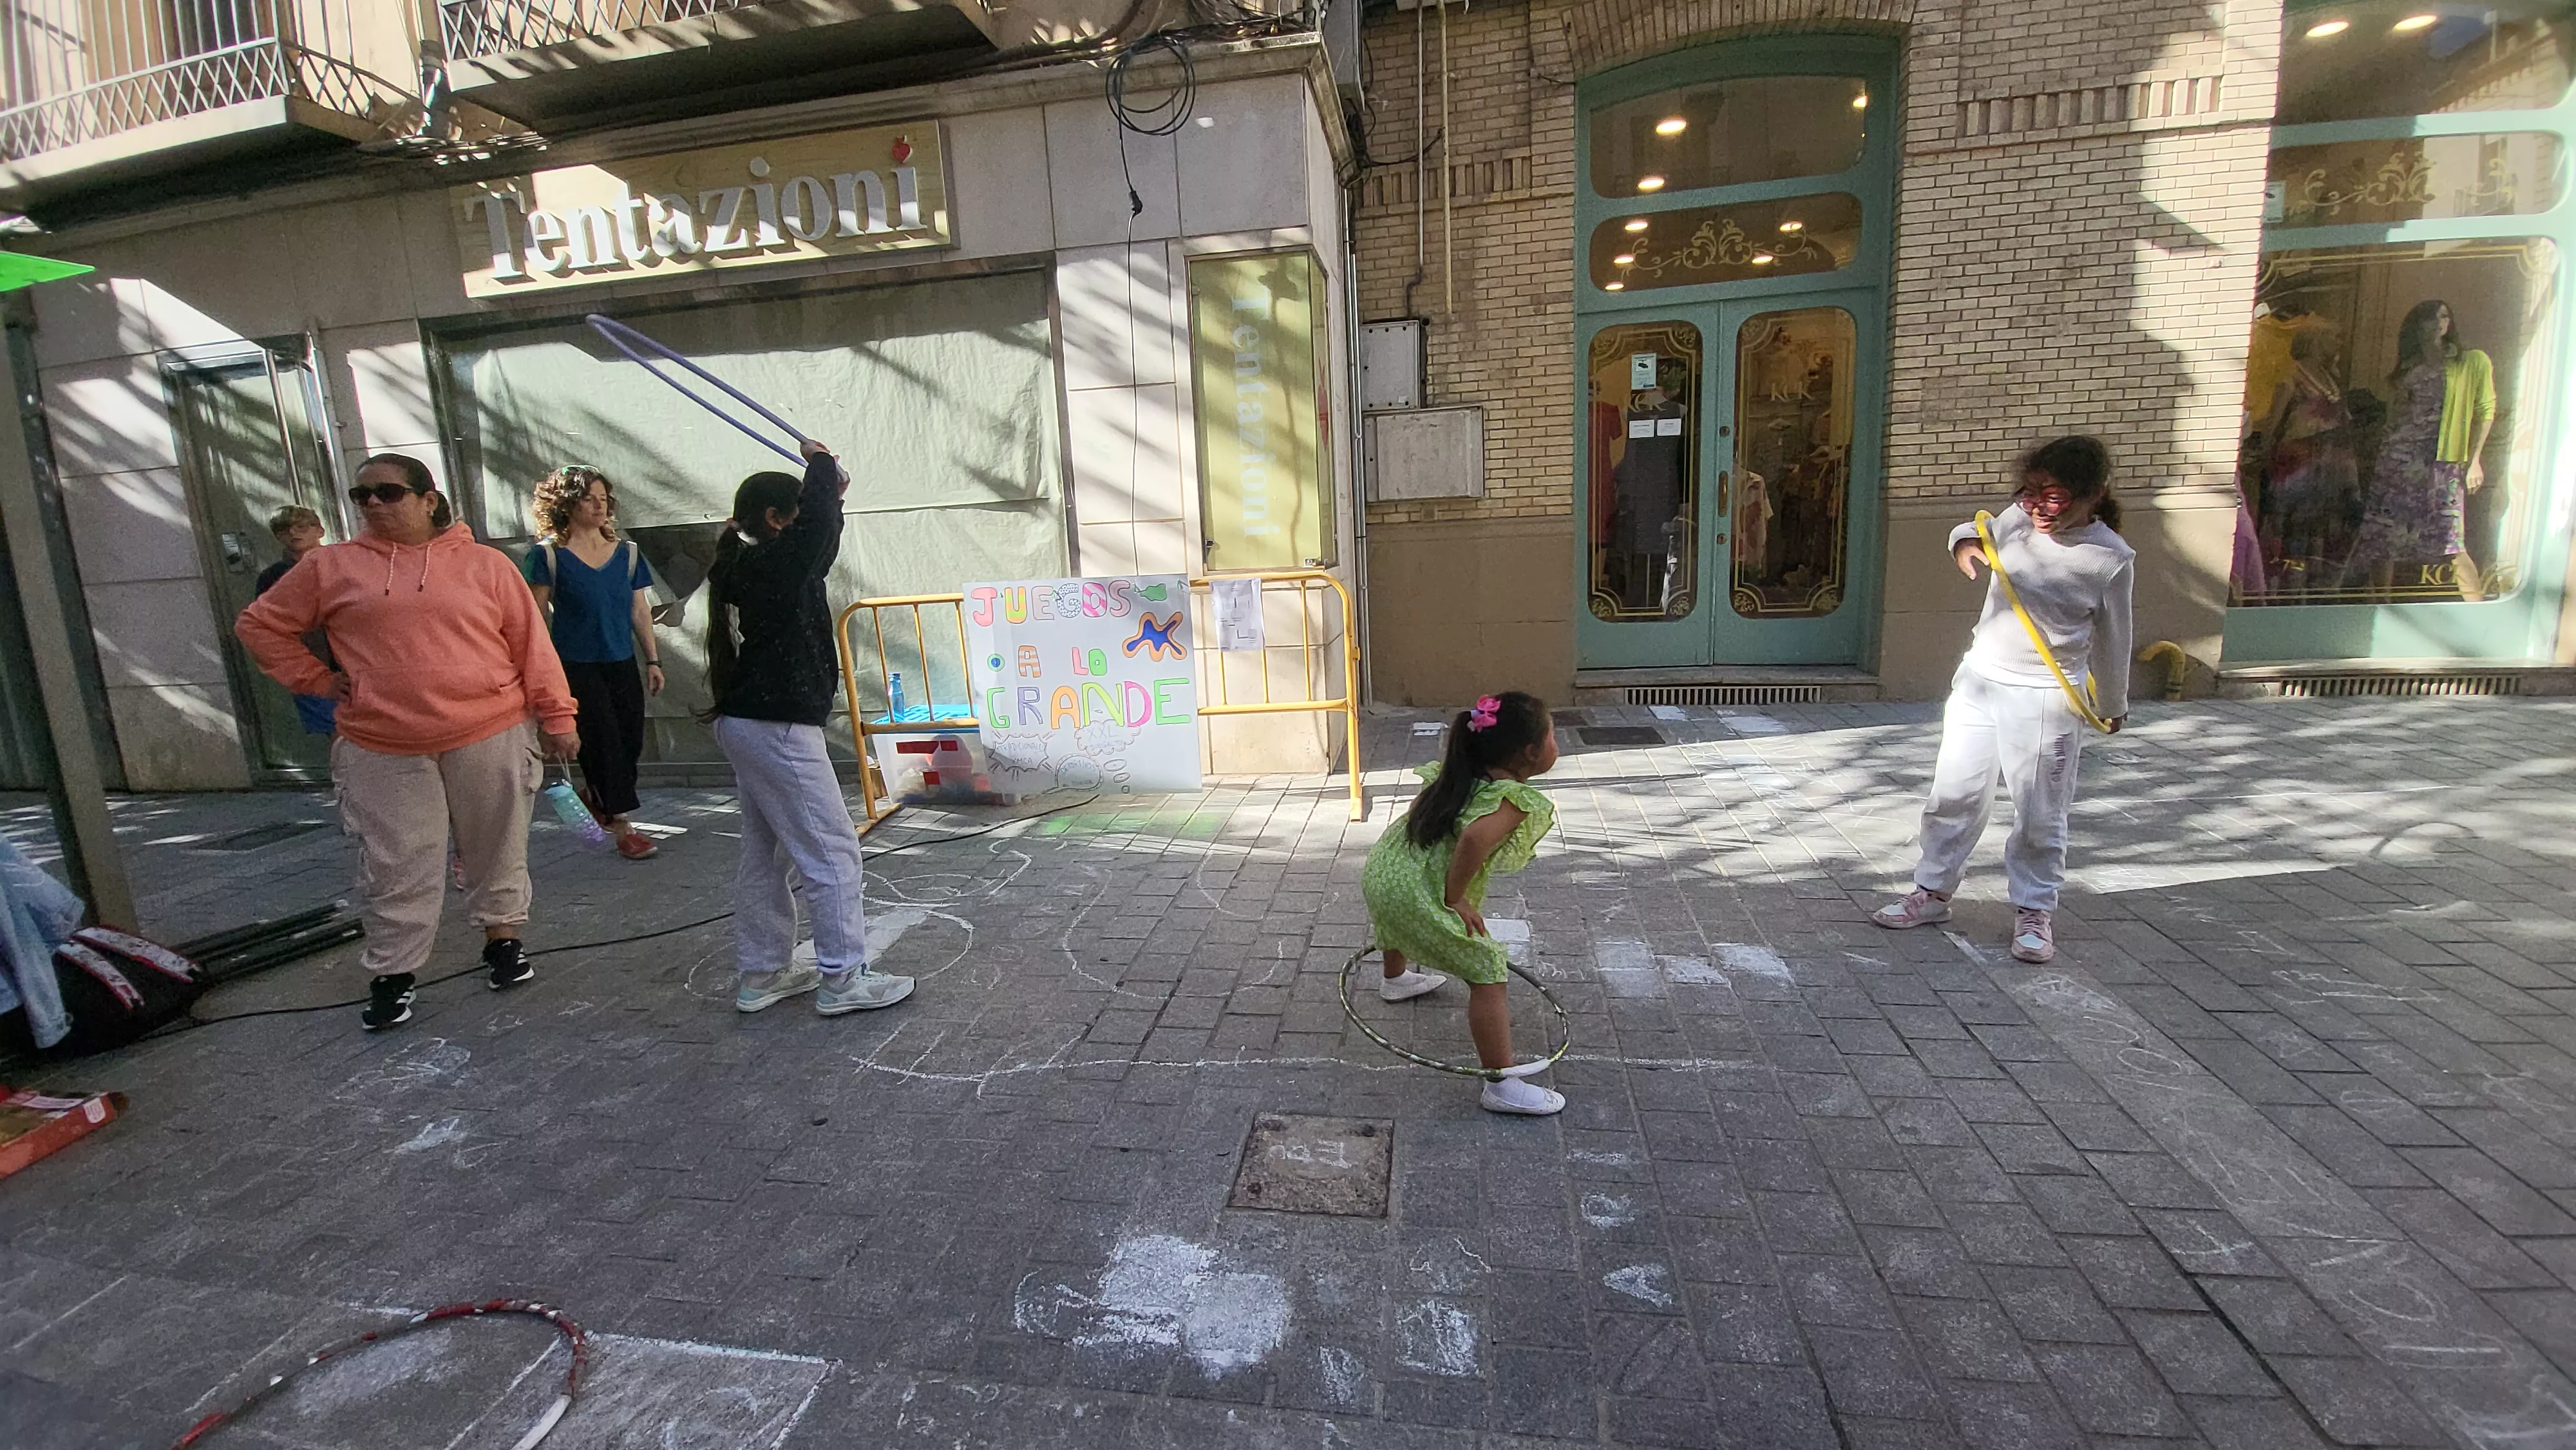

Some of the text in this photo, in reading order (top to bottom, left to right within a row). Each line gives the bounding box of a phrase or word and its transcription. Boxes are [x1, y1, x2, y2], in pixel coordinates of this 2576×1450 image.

[464, 135, 929, 279] Tentazioni
[1232, 286, 1280, 537] Tentazioni
[971, 579, 1132, 627] JUEGOS
[1018, 645, 1108, 678] A LO
[986, 677, 1192, 730] GRANDE
[1087, 724, 1119, 742] XXL
